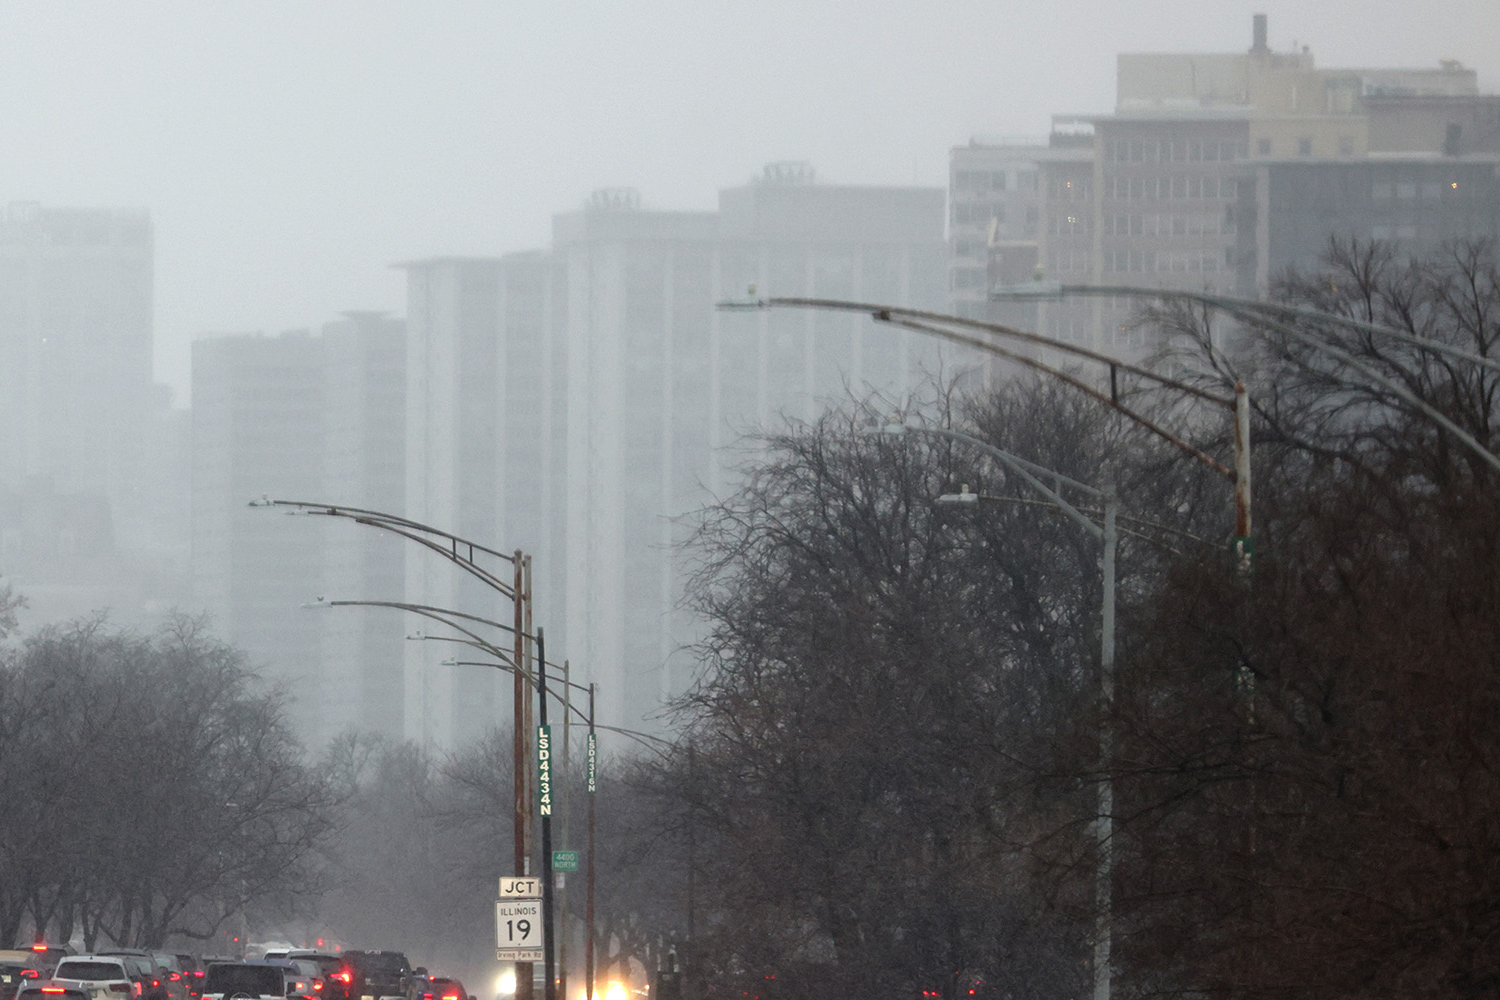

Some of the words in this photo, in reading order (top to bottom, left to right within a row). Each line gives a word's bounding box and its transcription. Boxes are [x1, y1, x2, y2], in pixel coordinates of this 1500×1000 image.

[556, 853, 575, 861] 4400
[555, 861, 576, 869] NORTH
[505, 881, 534, 893] JCT
[501, 907, 537, 916] ILLINOIS
[507, 919, 531, 941] 19
